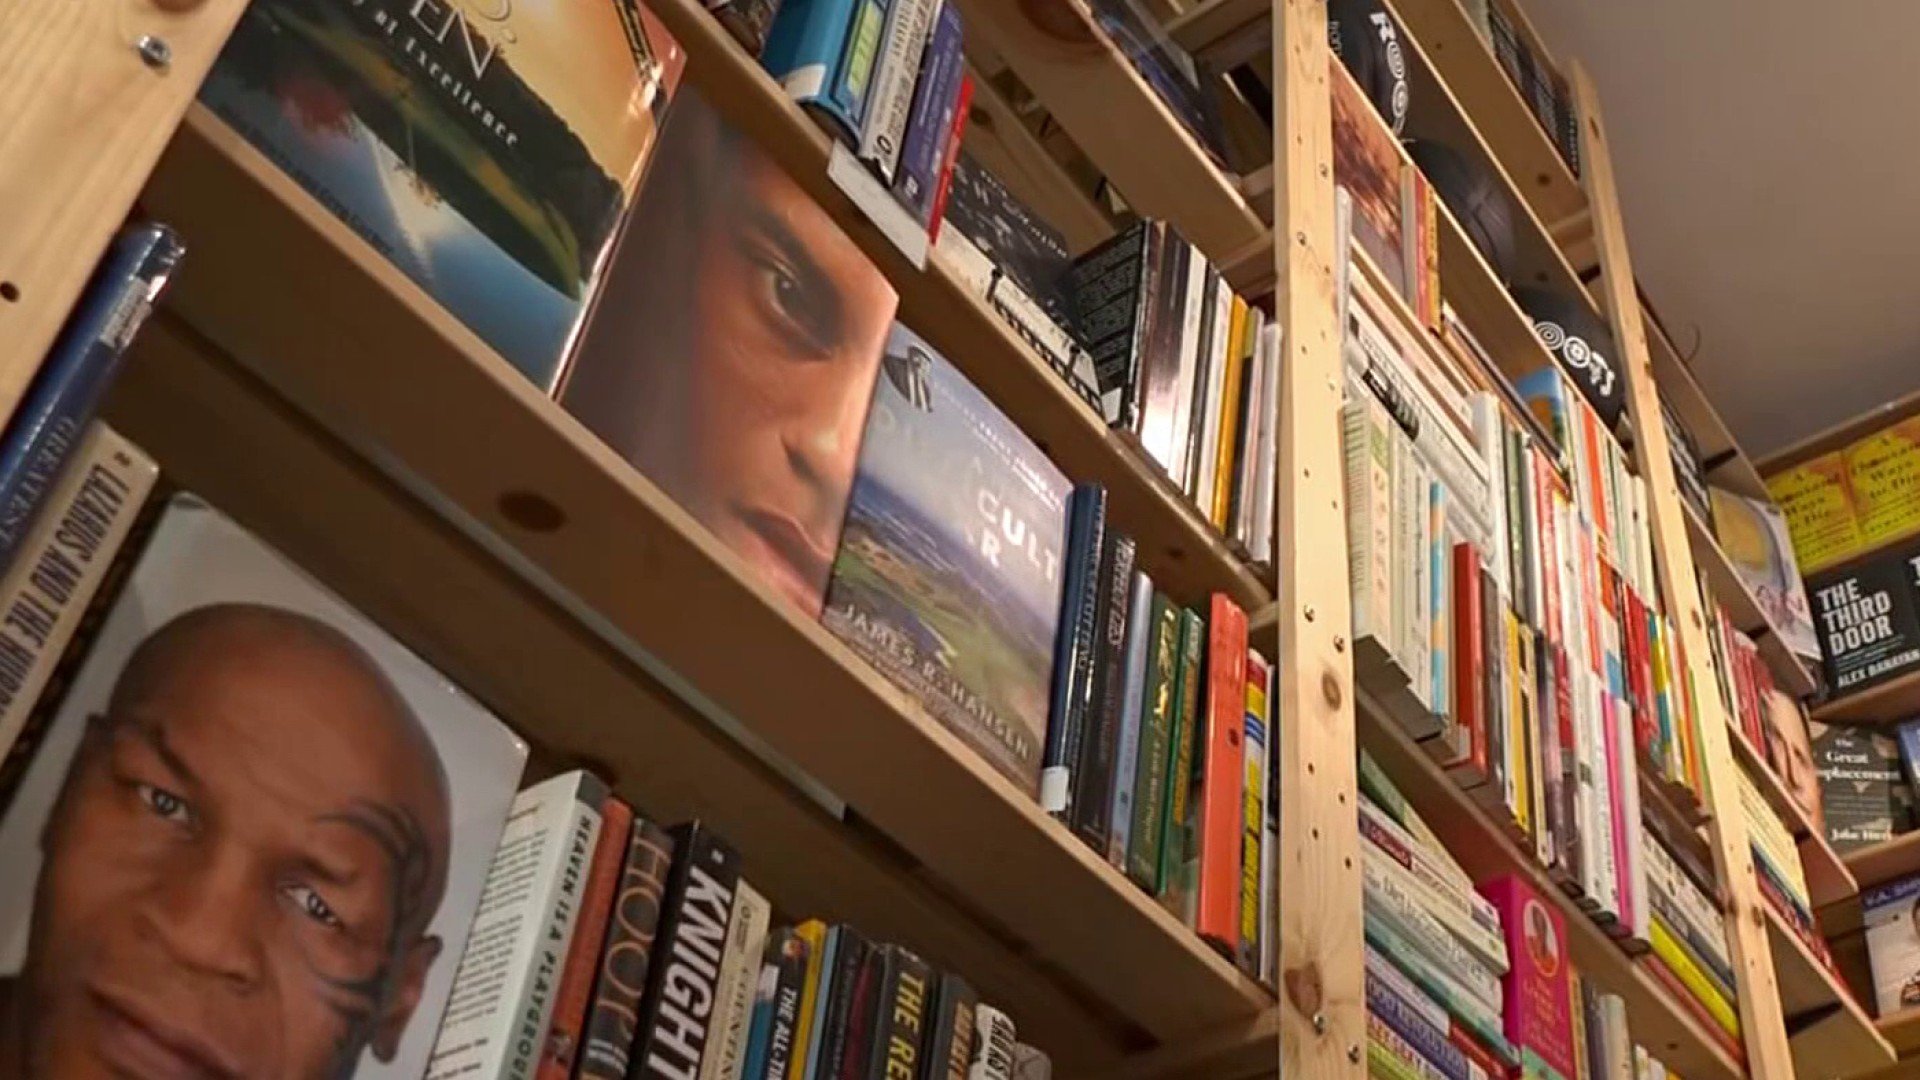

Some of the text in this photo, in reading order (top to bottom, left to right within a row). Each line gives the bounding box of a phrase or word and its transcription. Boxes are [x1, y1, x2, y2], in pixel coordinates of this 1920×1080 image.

[405, 36, 519, 148] Excellence
[1527, 318, 1616, 397] OOTS
[53, 463, 130, 563] LAZARUS
[29, 544, 84, 606] AND
[1816, 577, 1860, 612] THE
[4, 590, 59, 649] THE
[1821, 590, 1892, 633] THIRD
[1828, 614, 1894, 657] DOOR
[845, 603, 917, 667] JAMES
[950, 680, 1028, 761] HANSEN
[1825, 751, 1869, 764] Great
[561, 814, 593, 898] HEAVEN
[548, 923, 563, 942] A
[553, 899, 571, 923] IS
[647, 864, 735, 1080] KNIGHT
[776, 984, 798, 1024] THE
[884, 971, 925, 1080] THE RE
